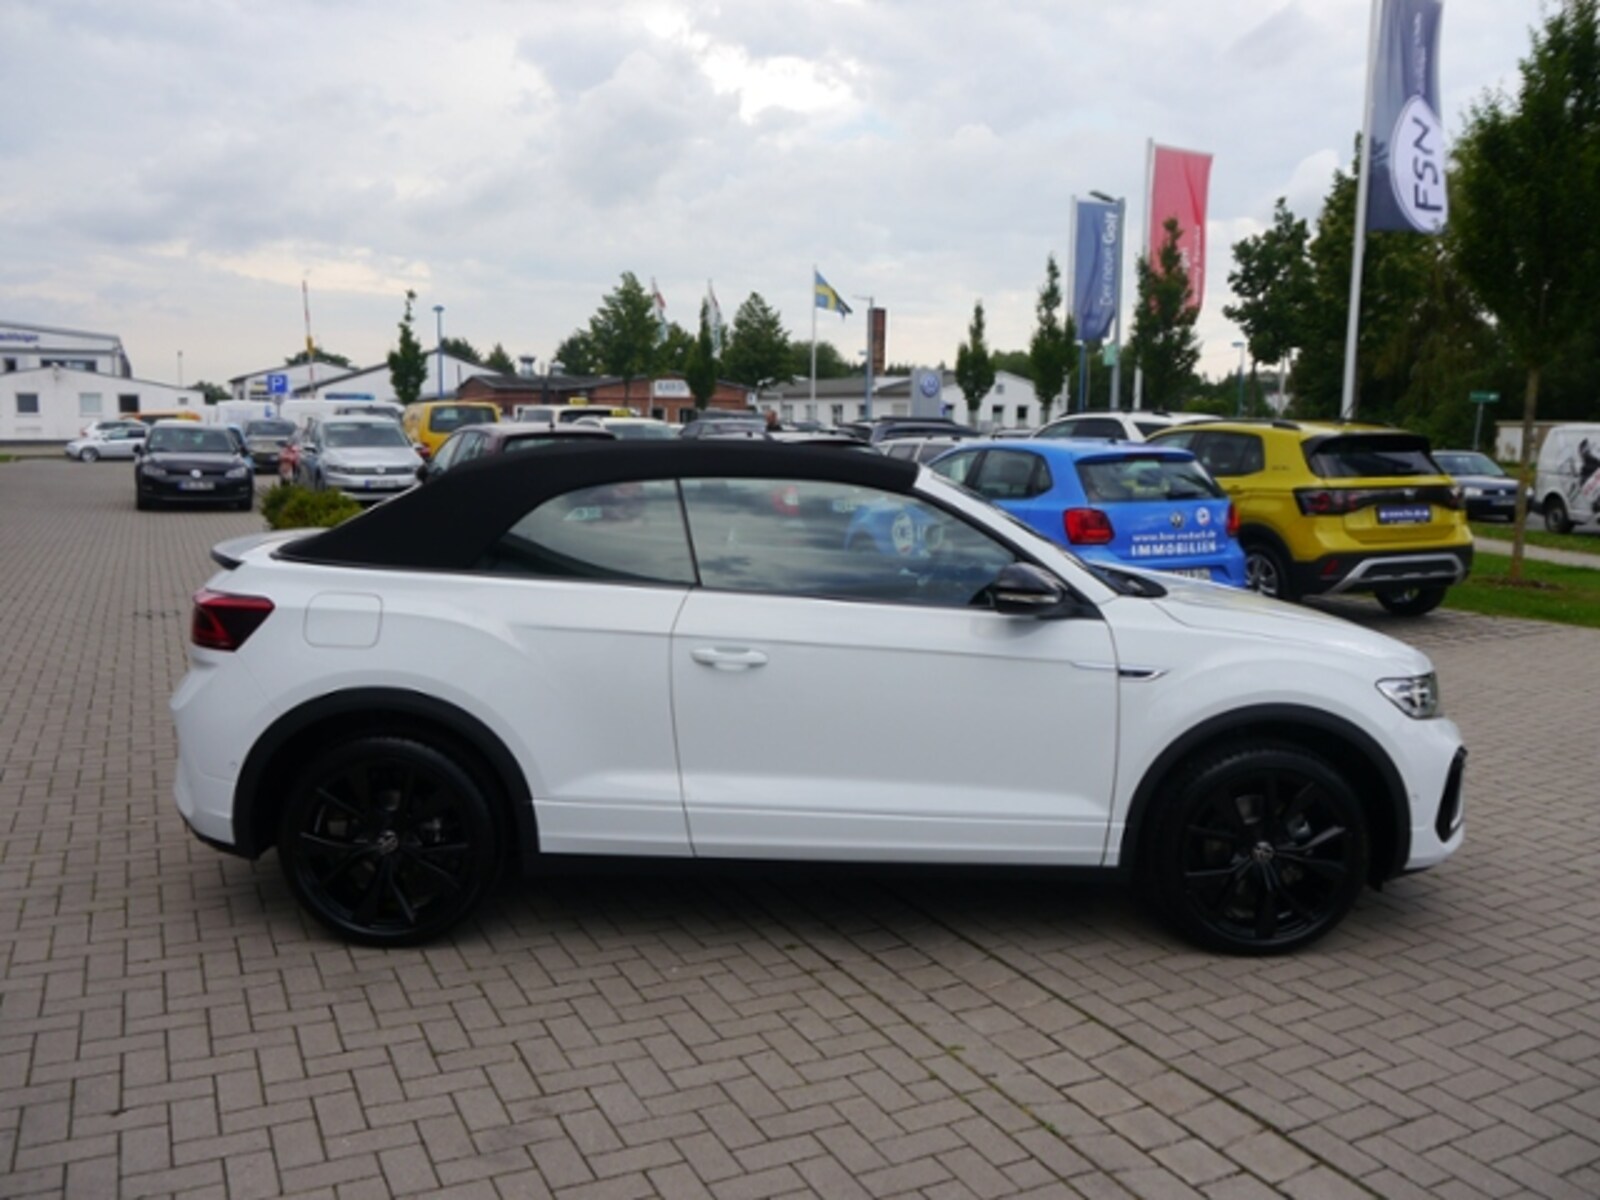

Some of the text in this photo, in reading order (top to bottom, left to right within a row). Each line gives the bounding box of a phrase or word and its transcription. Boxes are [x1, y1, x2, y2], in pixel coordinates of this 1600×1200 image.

[1412, 116, 1443, 212] FSN
[1100, 211, 1118, 306] Der neue Golf
[1131, 541, 1217, 557] IMMOBILIEN
